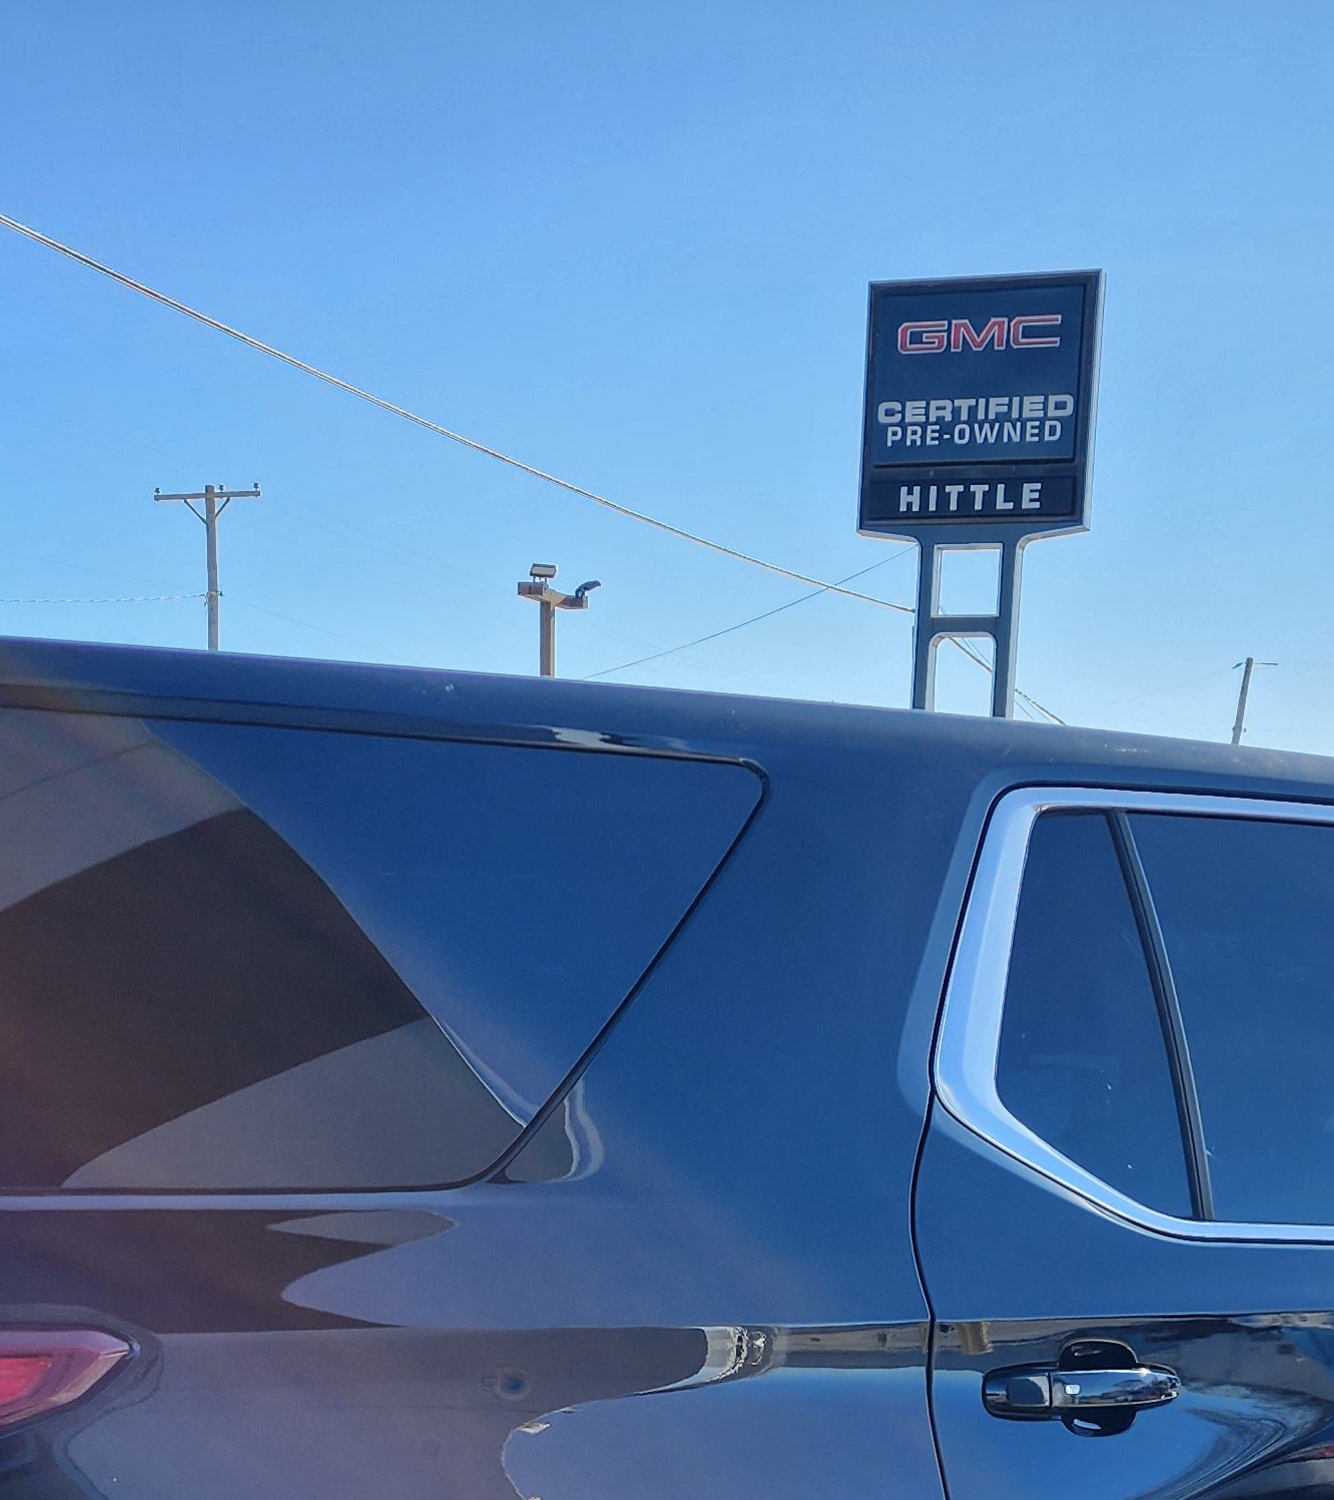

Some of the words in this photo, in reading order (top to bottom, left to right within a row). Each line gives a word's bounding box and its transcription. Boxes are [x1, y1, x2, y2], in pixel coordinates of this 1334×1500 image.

[898, 314, 1062, 355] GMC
[877, 394, 1075, 424] CERTIFIED
[886, 420, 1062, 447] PRE-OWNED
[899, 482, 1042, 512] HITTLE
